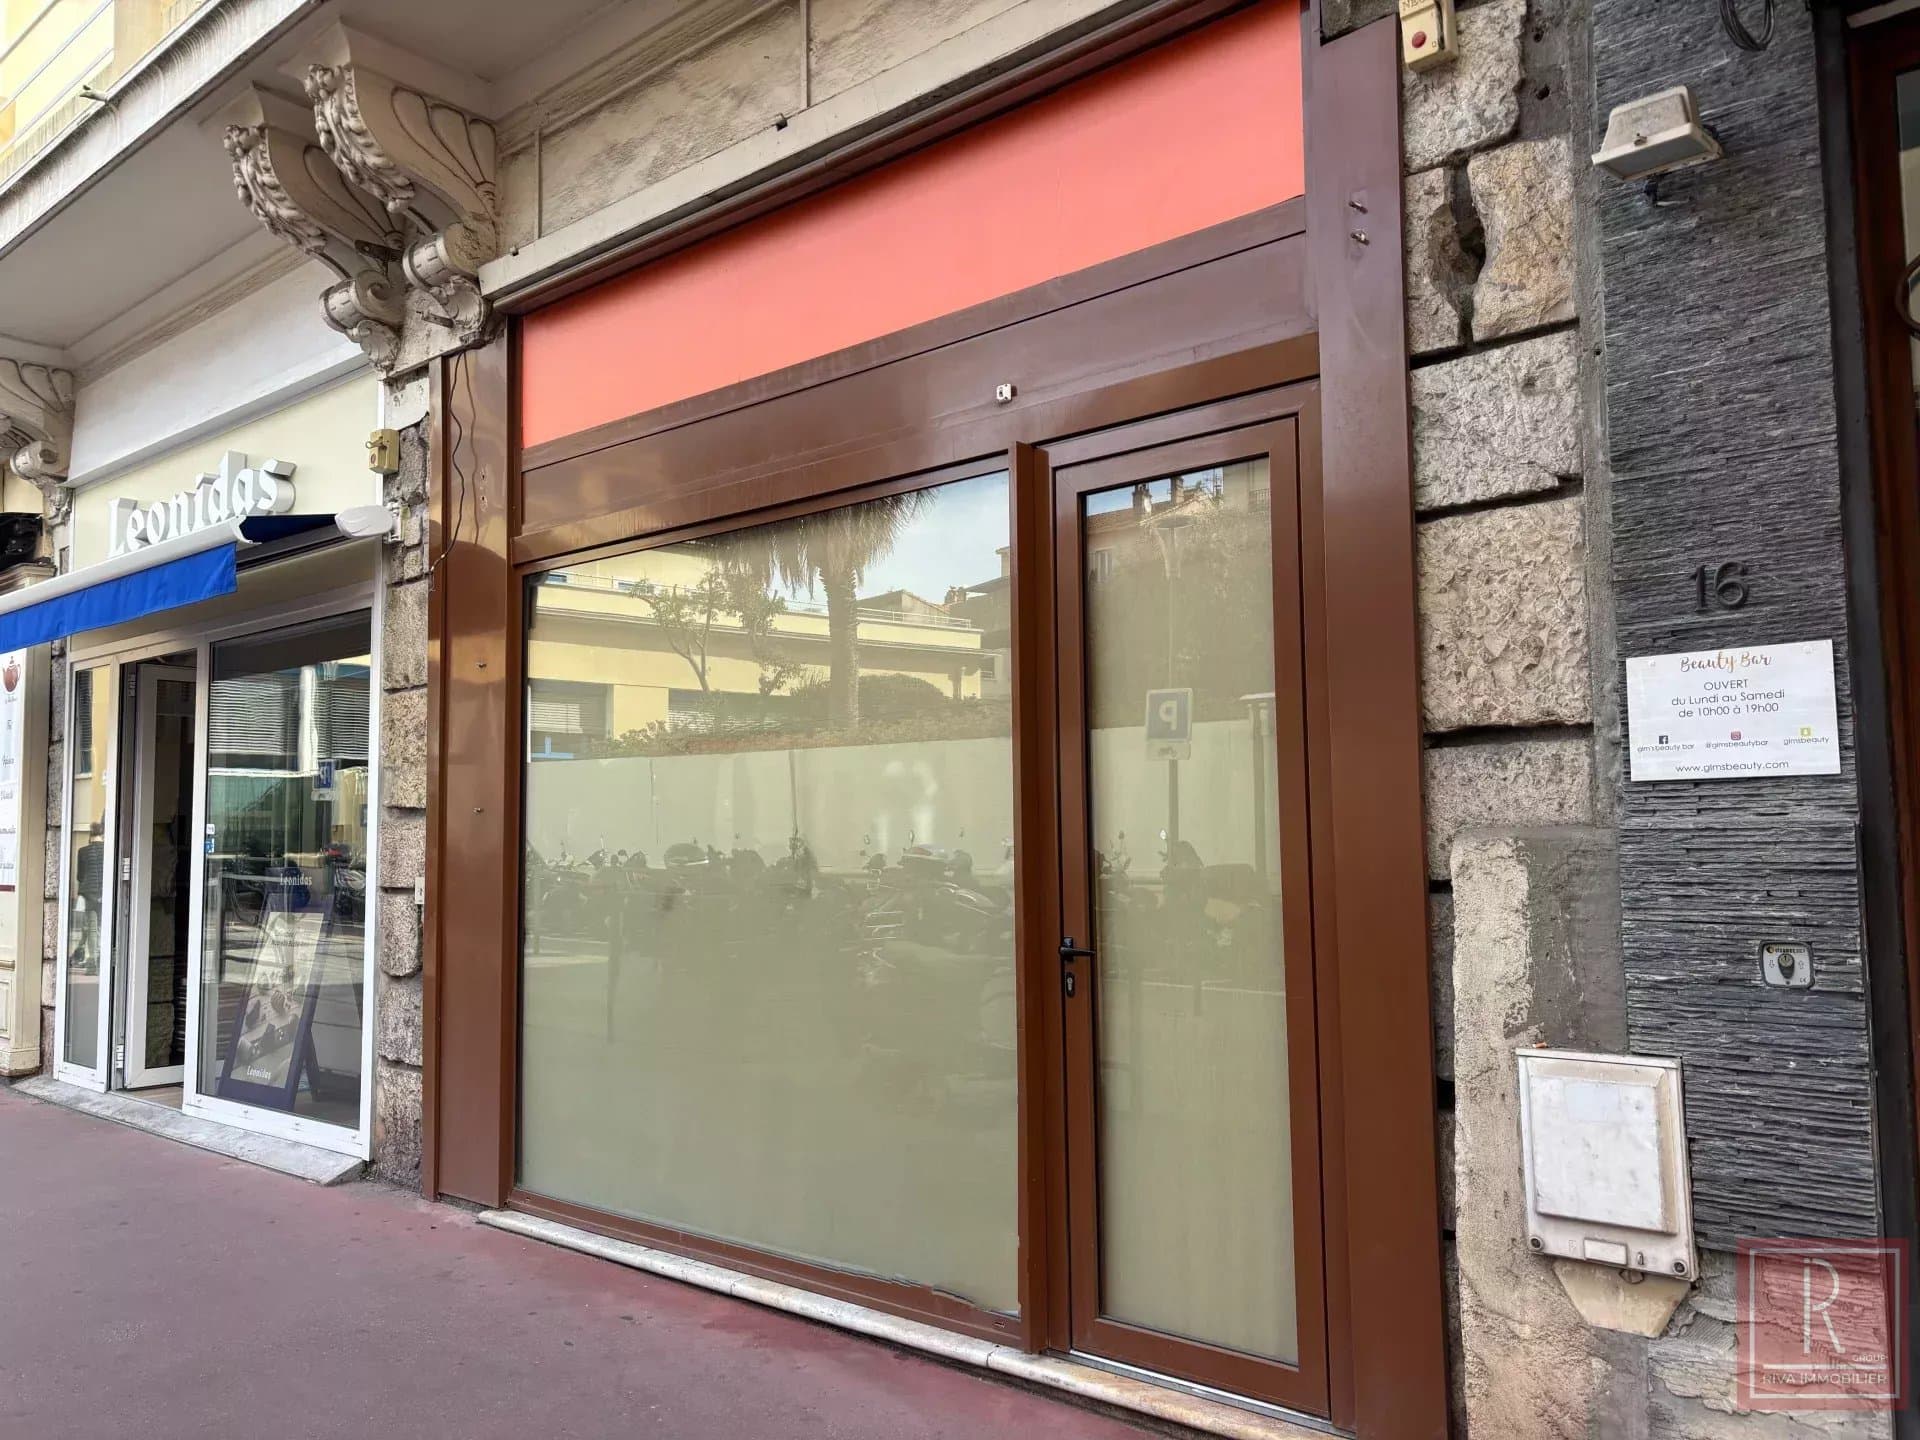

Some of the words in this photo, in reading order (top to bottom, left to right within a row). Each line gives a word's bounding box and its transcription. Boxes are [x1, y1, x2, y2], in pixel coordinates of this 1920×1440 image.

[107, 450, 297, 559] Leonidas
[1690, 560, 1748, 612] 16
[1680, 651, 1734, 673] Beauty
[1740, 650, 1773, 667] Bar
[1703, 679, 1749, 691] OUVERT
[1671, 696, 1686, 706] du
[1689, 693, 1719, 705] Lundi
[1721, 694, 1737, 702] au
[1740, 688, 1785, 701] Samedi
[1678, 708, 1694, 718] de
[1698, 705, 1730, 717] 10h00
[1733, 705, 1741, 714] à
[1746, 702, 1779, 713] 19h00
[1675, 761, 1790, 773] www.gimsbeauty.com
